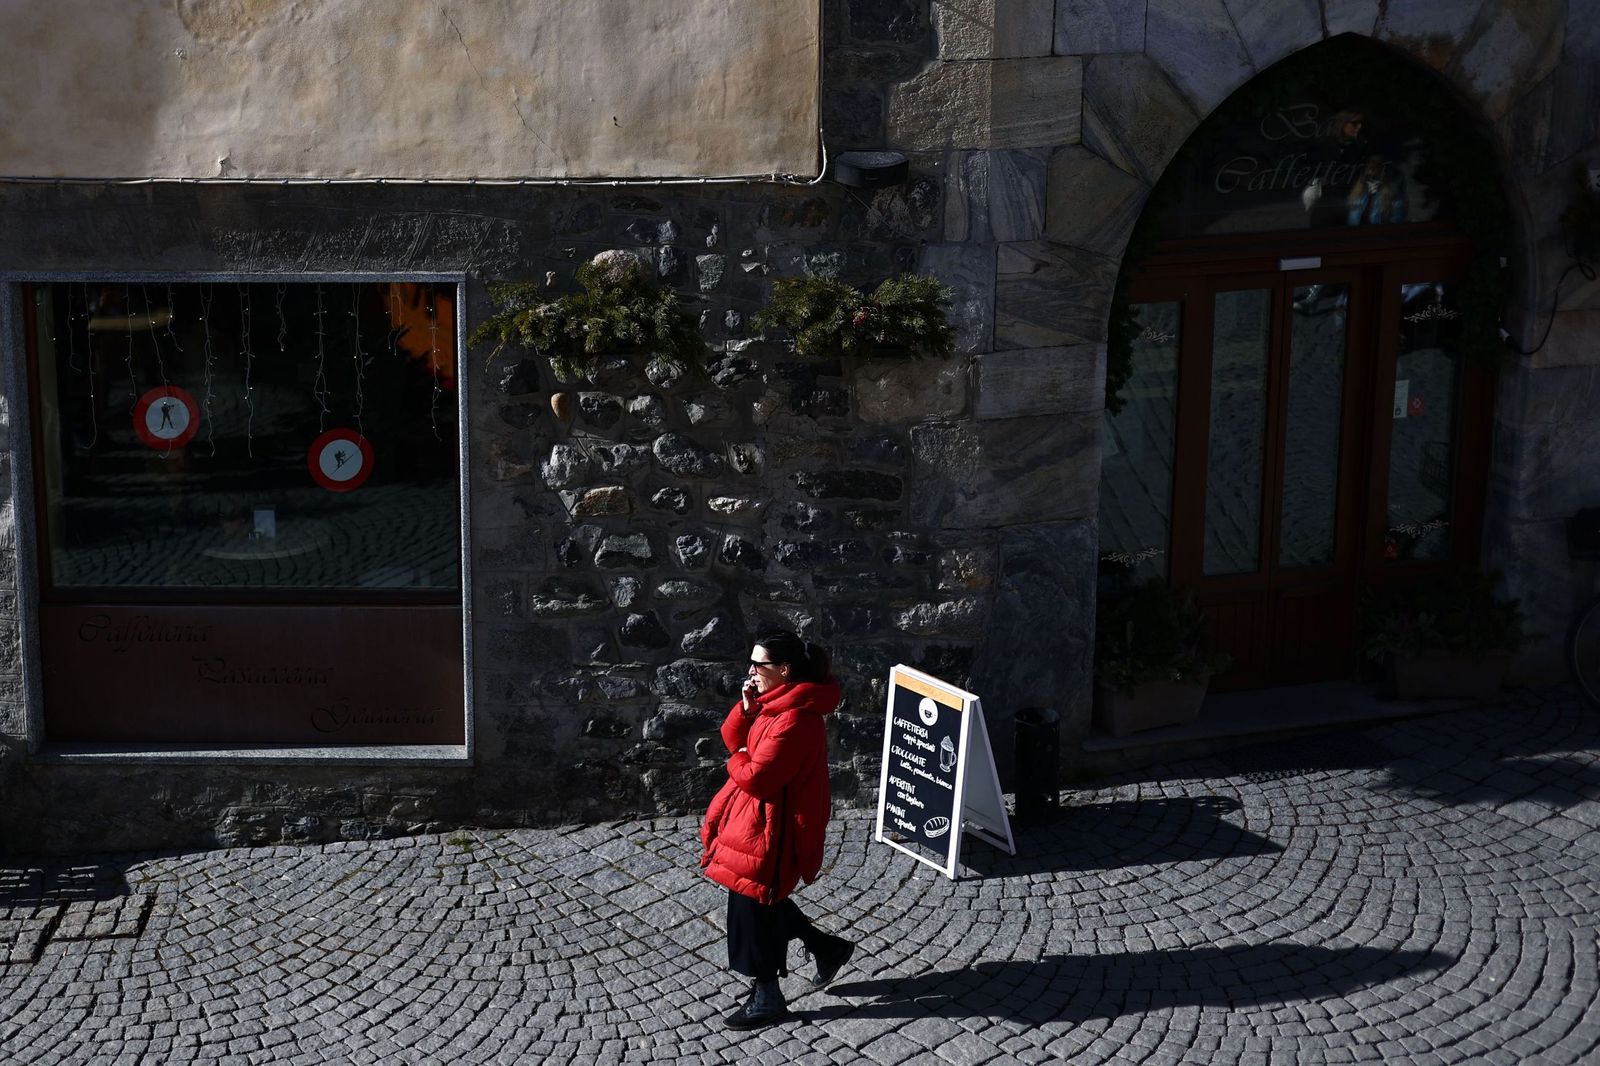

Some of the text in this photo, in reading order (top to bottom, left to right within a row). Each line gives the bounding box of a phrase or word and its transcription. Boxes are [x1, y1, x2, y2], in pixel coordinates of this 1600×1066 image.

[893, 716, 929, 739] CAFFETTERIA
[891, 745, 927, 767] CIOCCOLATE
[886, 802, 906, 818] PANINI
